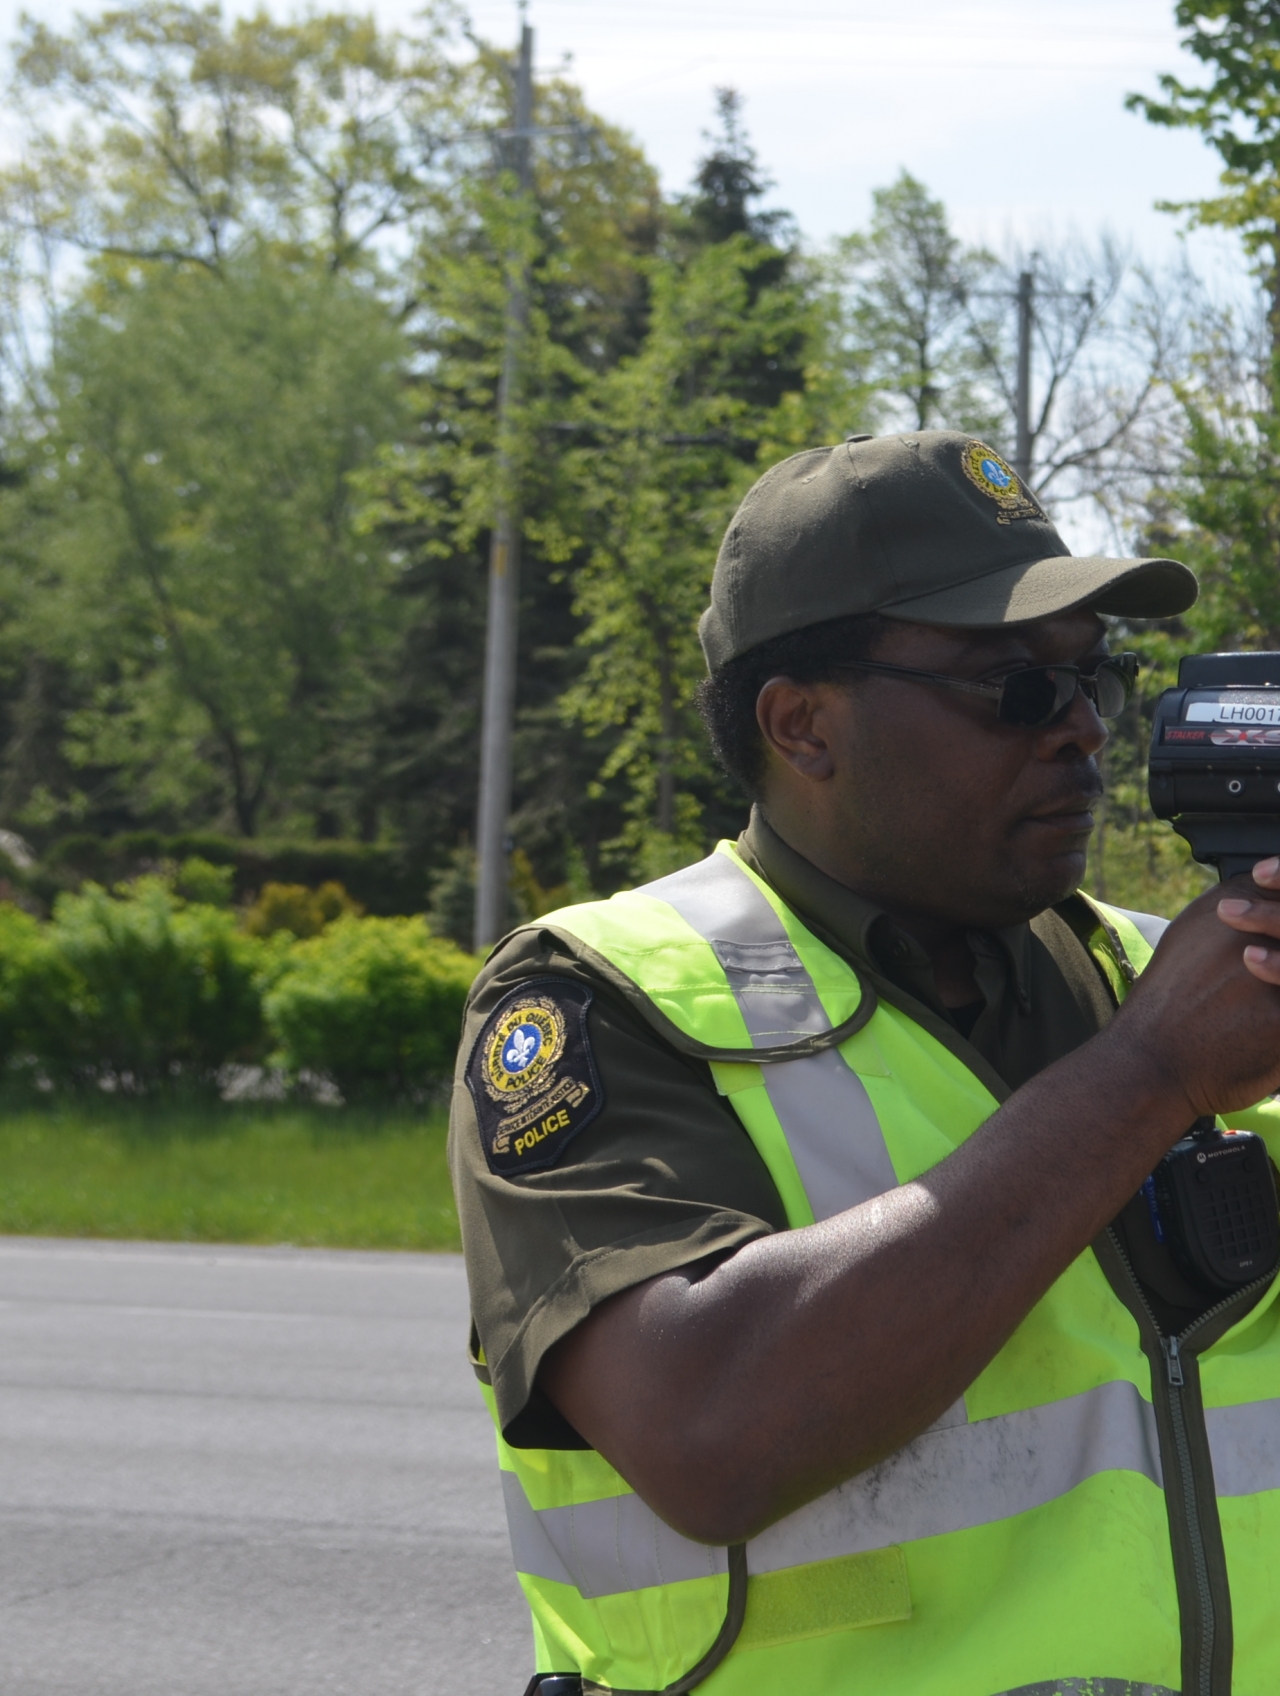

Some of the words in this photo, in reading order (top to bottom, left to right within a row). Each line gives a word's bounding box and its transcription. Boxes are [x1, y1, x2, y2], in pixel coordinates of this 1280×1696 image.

[1166, 731, 1205, 740] STALKER
[505, 1055, 545, 1089] POLICE
[514, 1109, 571, 1156] POLICE
[1207, 1145, 1246, 1159] MOTOROLA
